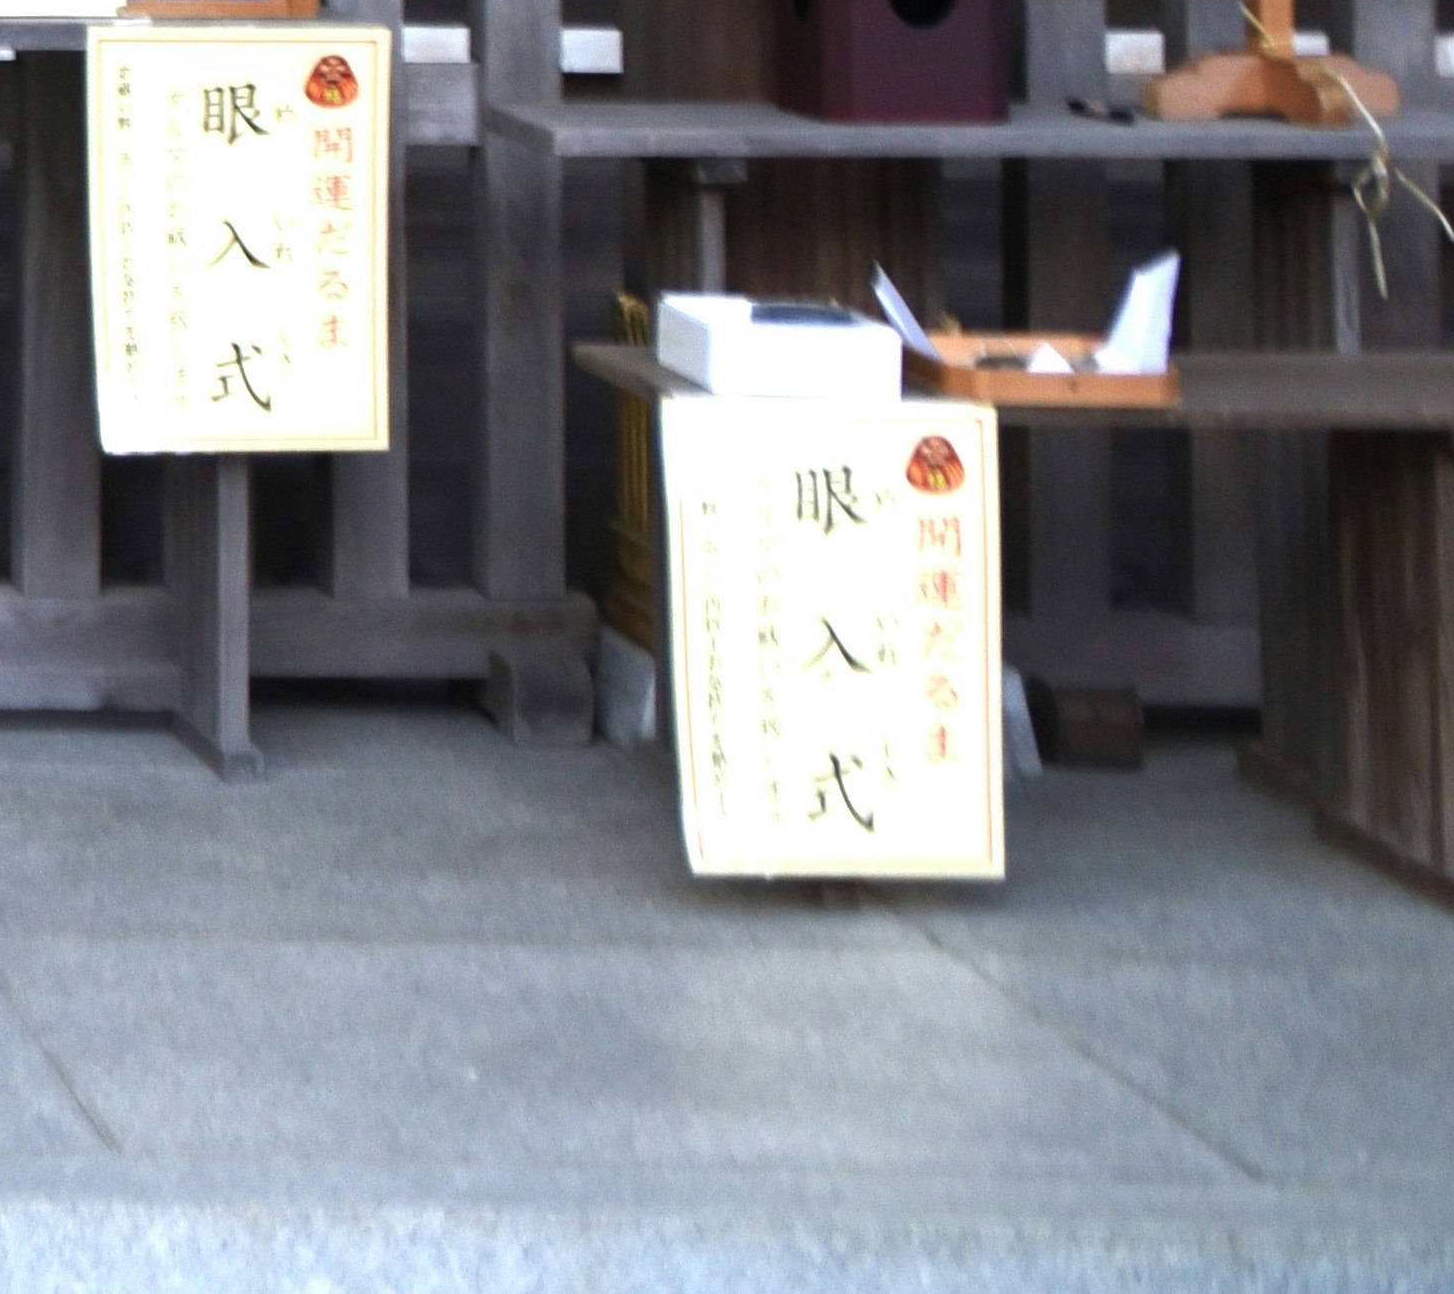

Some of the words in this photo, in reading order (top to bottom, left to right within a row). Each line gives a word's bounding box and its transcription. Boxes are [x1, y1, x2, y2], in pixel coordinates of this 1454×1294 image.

[201, 80, 273, 414] 眼入式
[311, 126, 356, 351] 開運だるま
[794, 464, 875, 834] 眼入式
[917, 516, 962, 765] 開運だるま
